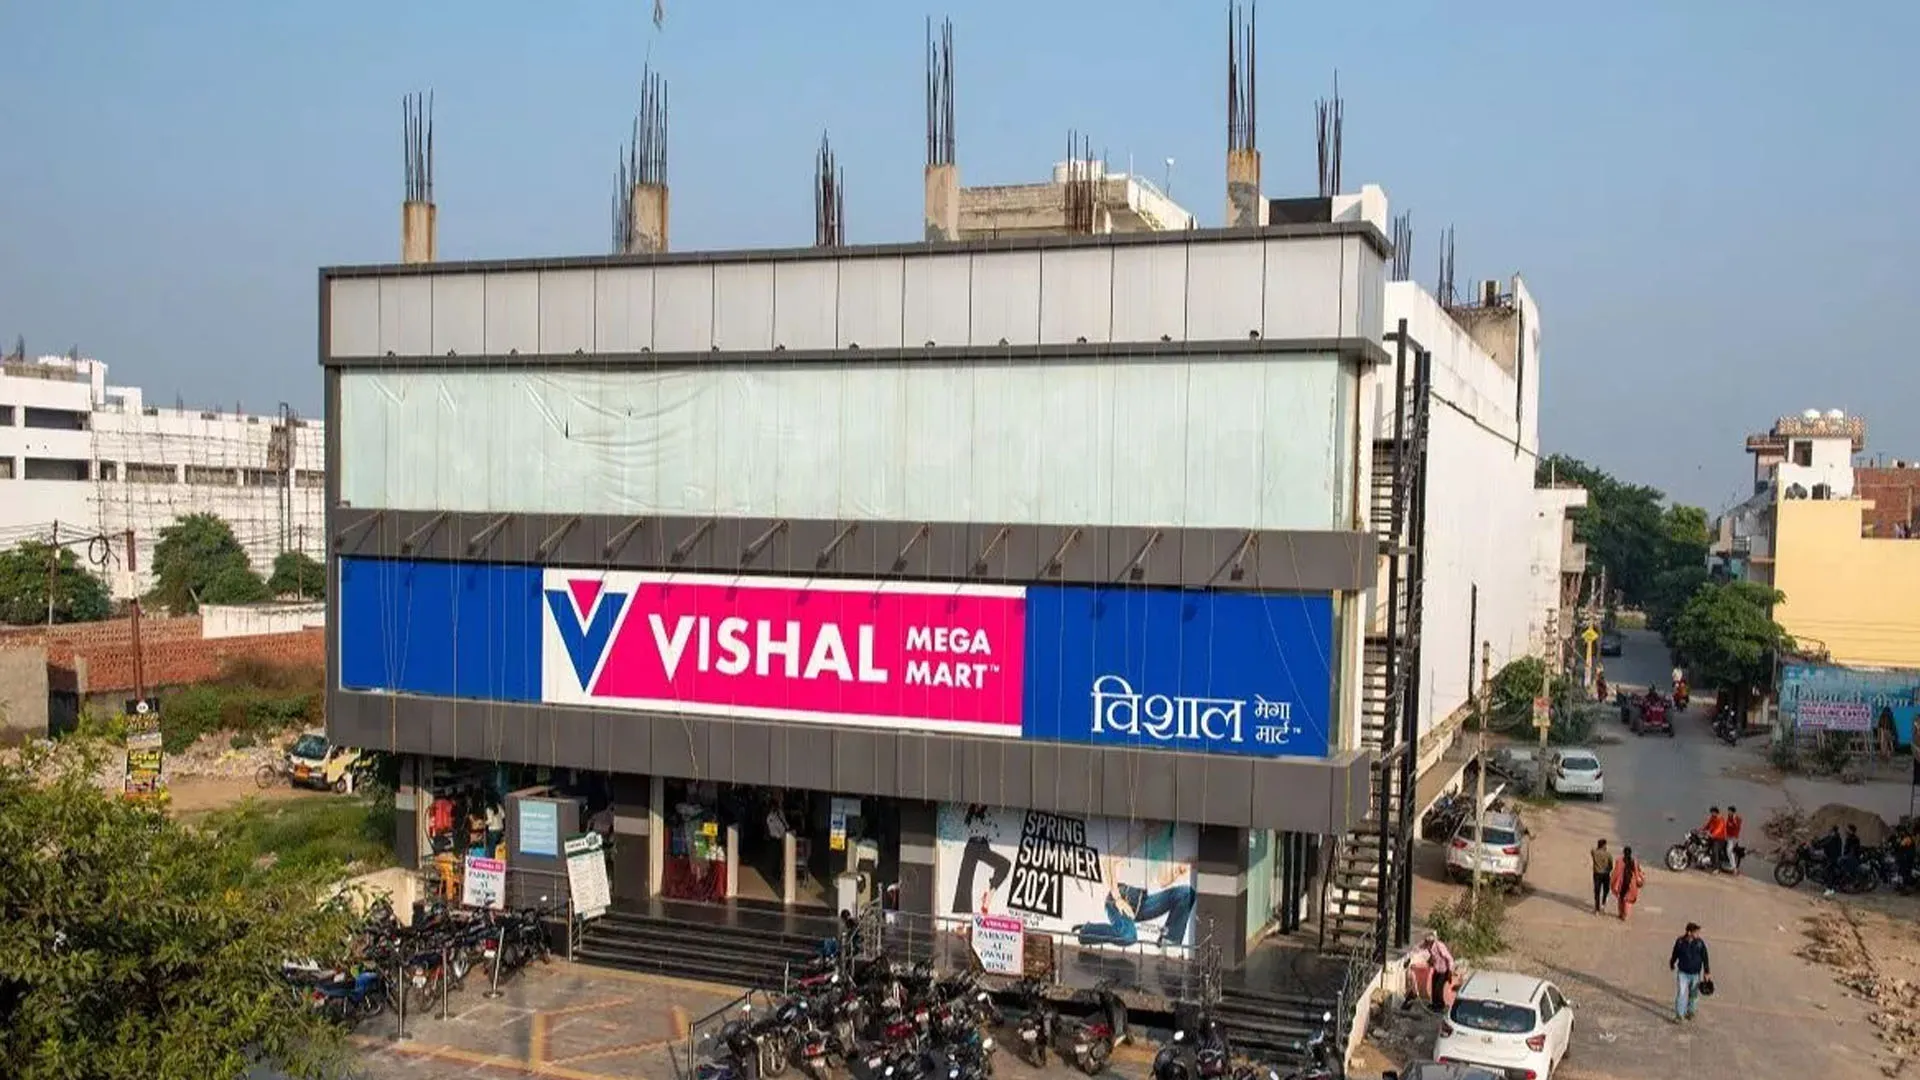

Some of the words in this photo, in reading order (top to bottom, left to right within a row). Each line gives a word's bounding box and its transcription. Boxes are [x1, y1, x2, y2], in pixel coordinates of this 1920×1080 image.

[648, 613, 889, 684] VISHAL
[906, 625, 992, 655] MEGA
[1091, 674, 1247, 743] विशाल
[1254, 693, 1291, 719] मेगा
[1025, 810, 1083, 844] SPRING
[1019, 836, 1099, 880] SUMMER
[1011, 866, 1059, 915] 2021
[978, 930, 1016, 942] PARKING
[992, 942, 1002, 951] AT
[980, 949, 1013, 961] OWNER
